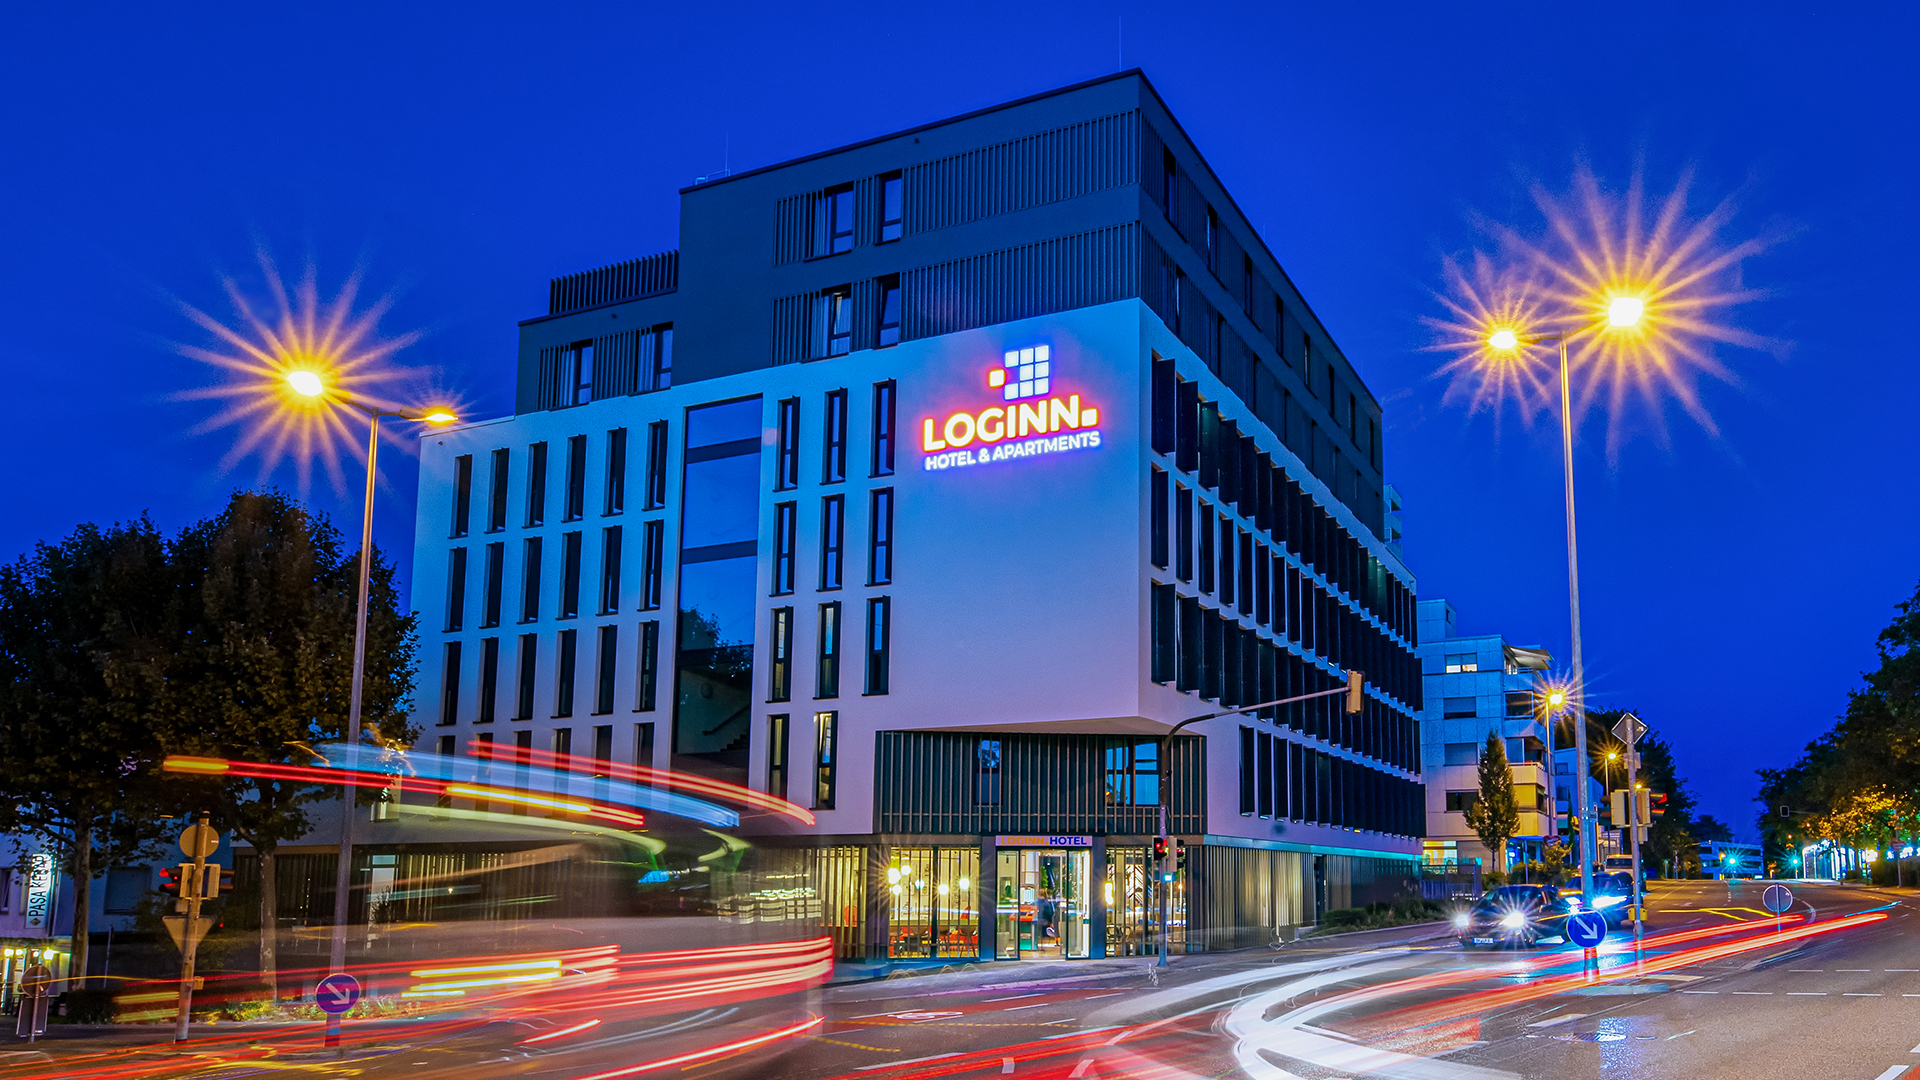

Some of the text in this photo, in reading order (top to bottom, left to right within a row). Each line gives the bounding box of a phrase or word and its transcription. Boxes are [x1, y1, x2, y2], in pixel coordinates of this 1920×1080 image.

[925, 431, 1101, 470] HOTEL & APARTMENTS
